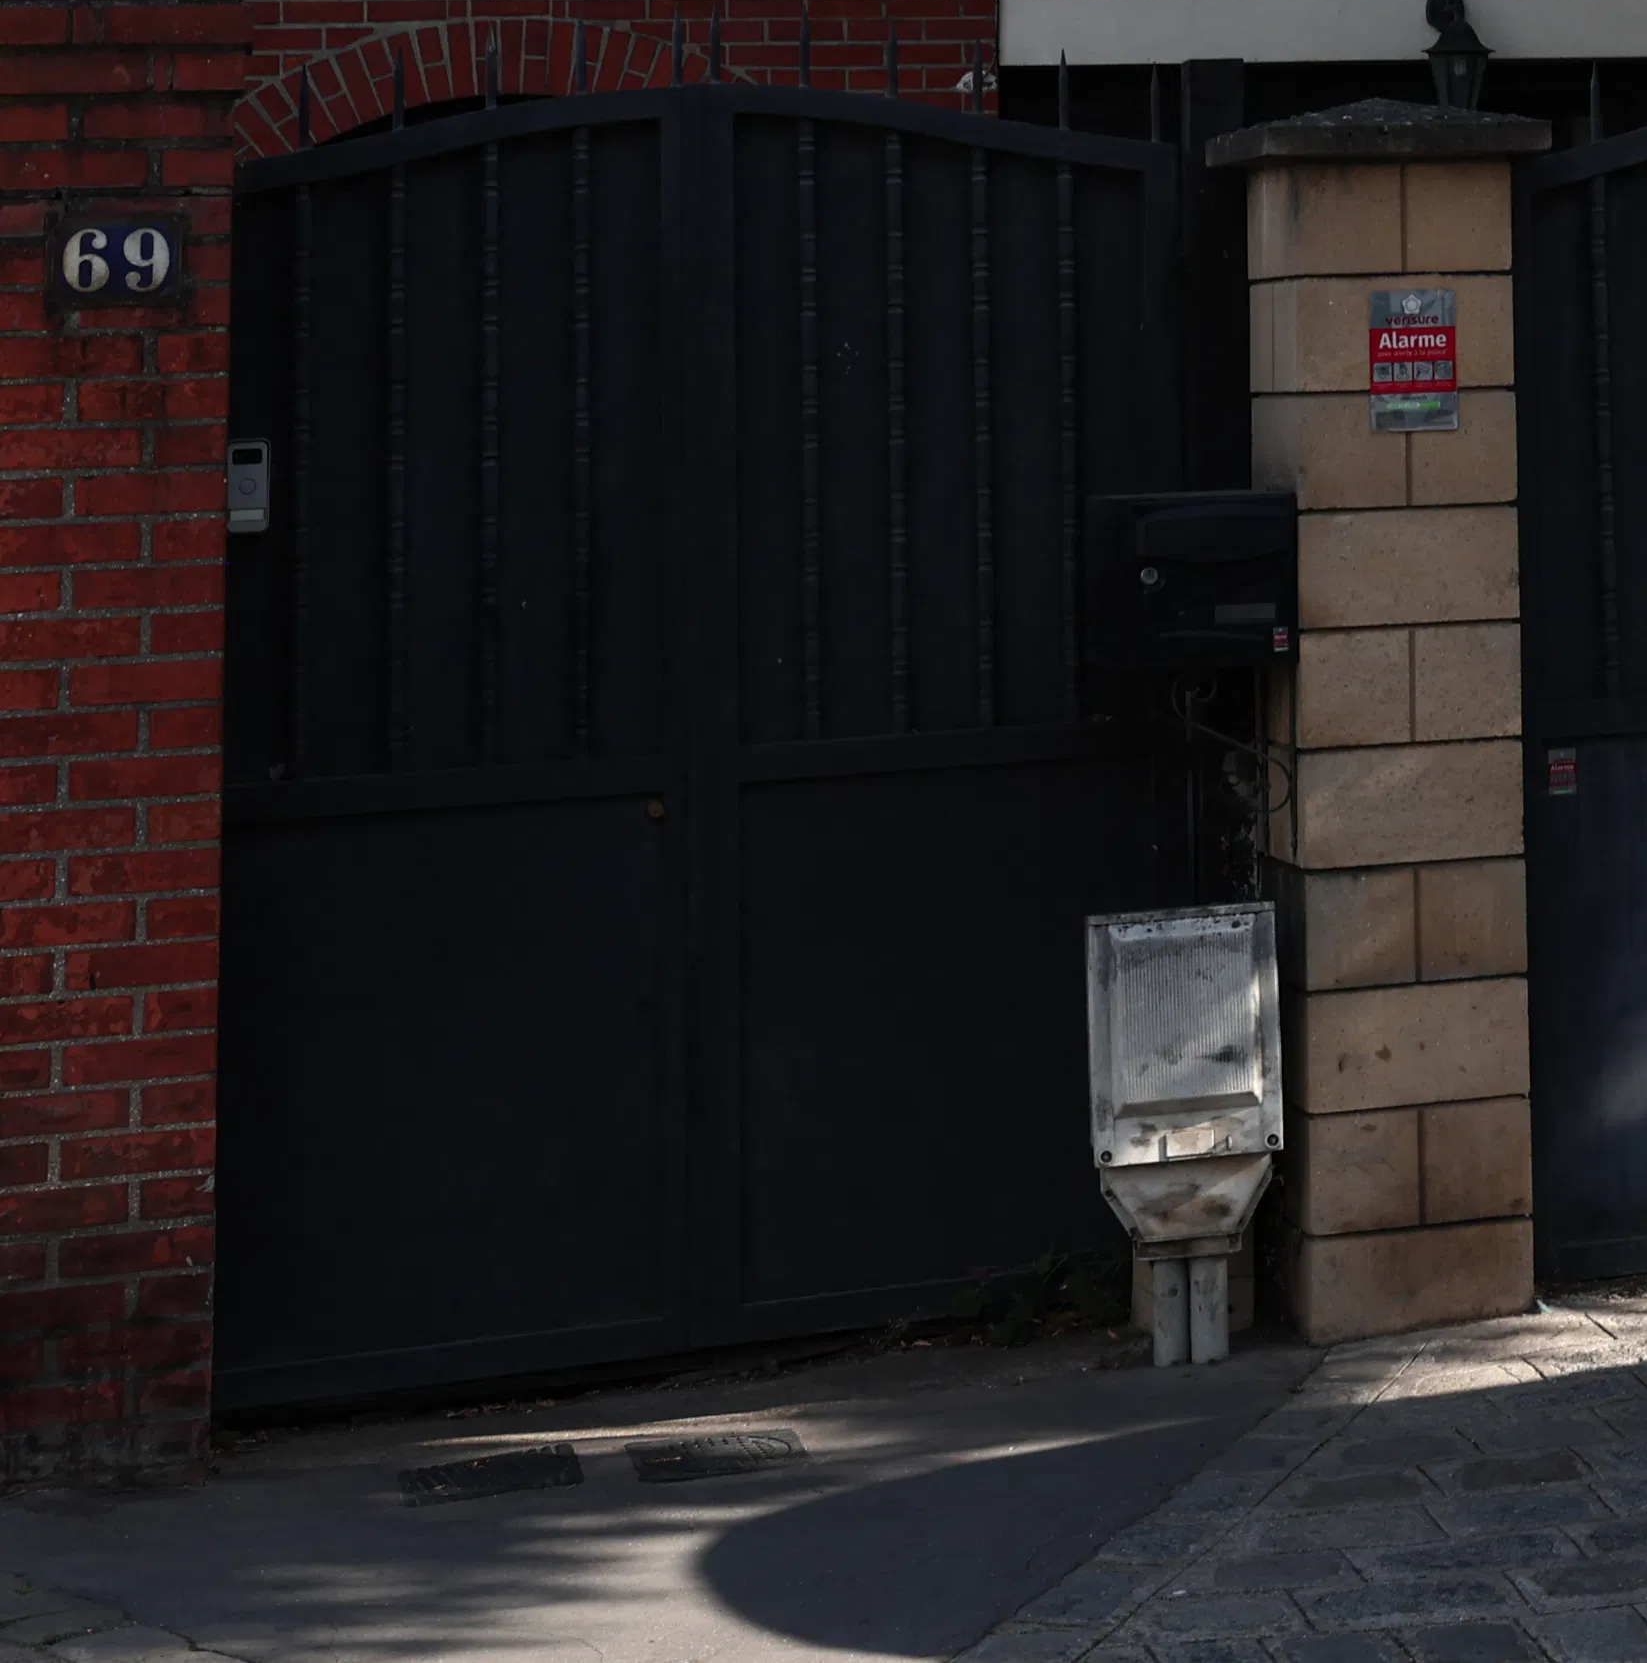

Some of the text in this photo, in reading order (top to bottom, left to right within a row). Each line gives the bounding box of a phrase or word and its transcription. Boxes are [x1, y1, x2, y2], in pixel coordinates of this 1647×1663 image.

[62, 227, 170, 293] 69
[1386, 314, 1440, 326] verisure
[1378, 331, 1448, 350] Alarme
